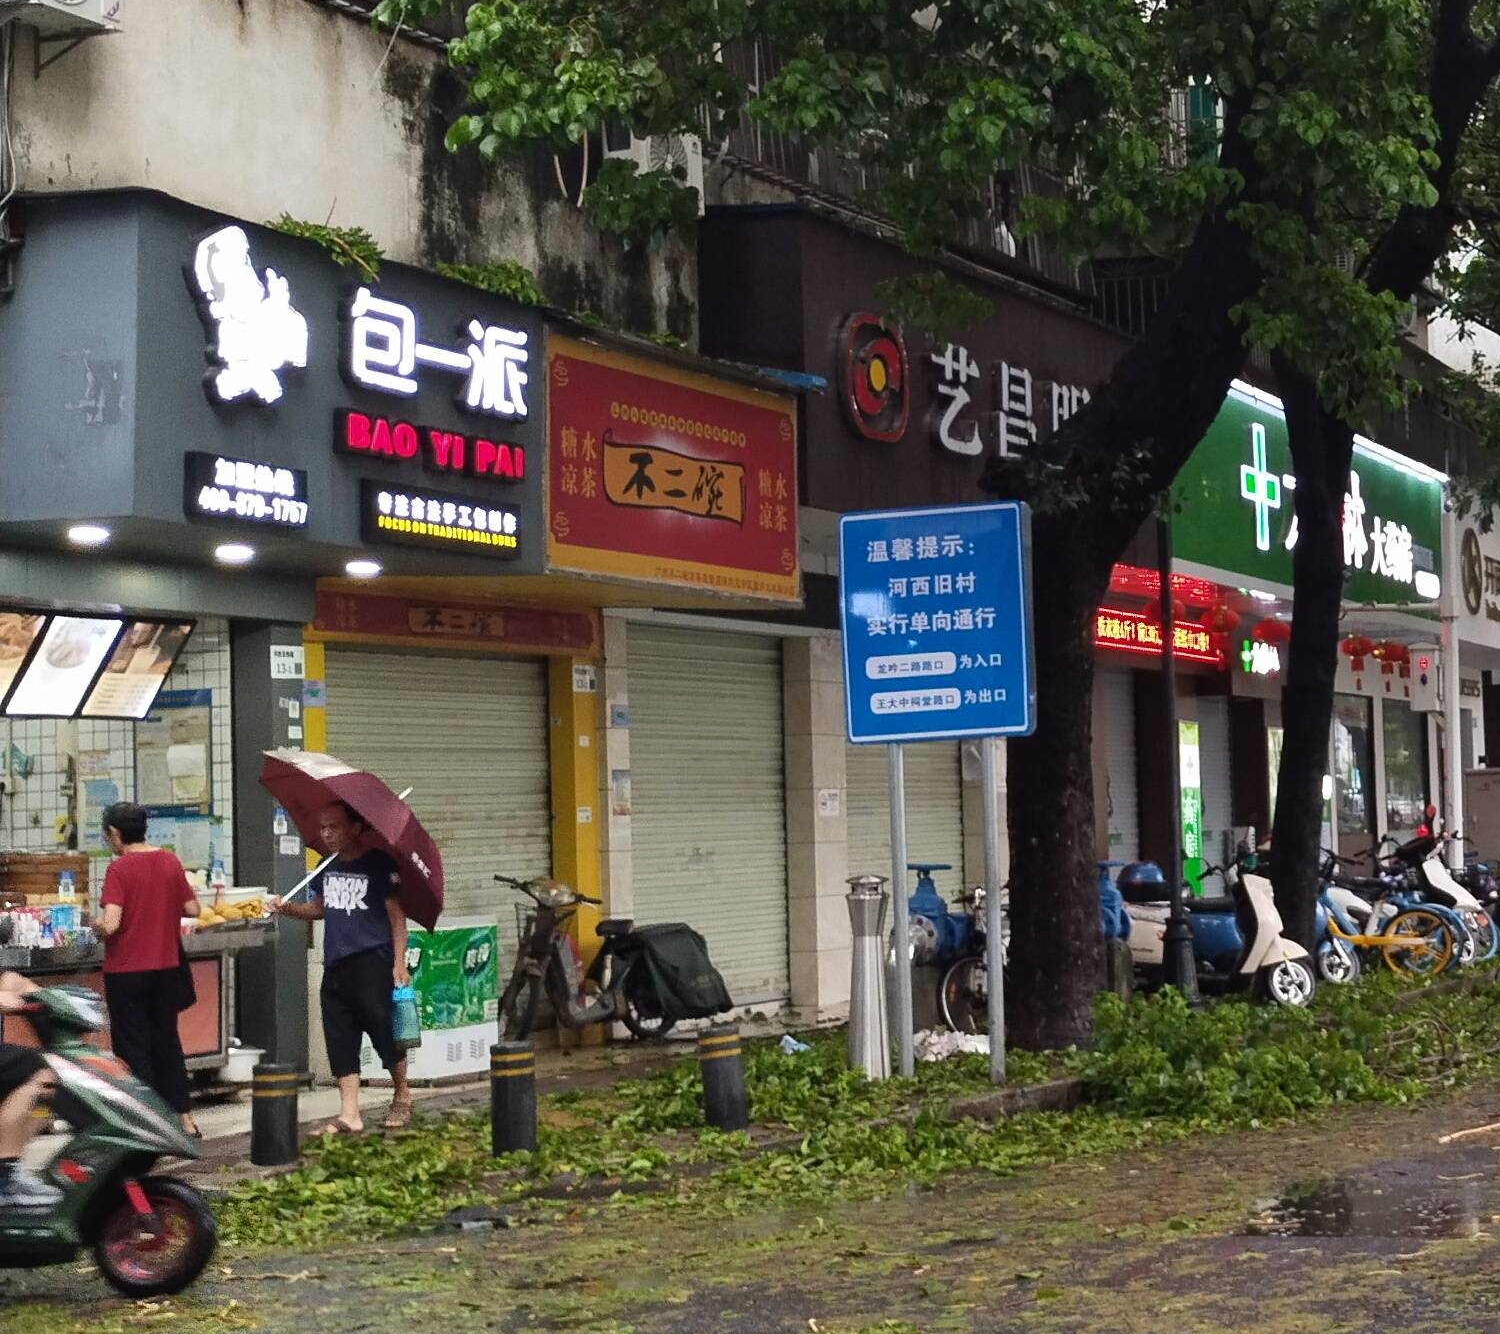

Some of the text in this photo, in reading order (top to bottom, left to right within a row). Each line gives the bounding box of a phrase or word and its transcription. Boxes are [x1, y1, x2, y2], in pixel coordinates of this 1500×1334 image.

[352, 287, 528, 415] 包一派
[347, 412, 524, 479] BAO YI PAI
[561, 427, 597, 462] 糖水
[561, 465, 596, 499] 凉茶
[622, 452, 725, 516] 不二碗
[757, 469, 787, 500] 糖水
[758, 502, 788, 533] 凉茶
[888, 572, 976, 598] 河西旧村
[867, 607, 996, 637] 实行单向通行
[959, 654, 1002, 669] 为入口
[964, 688, 1007, 705] 为出口
